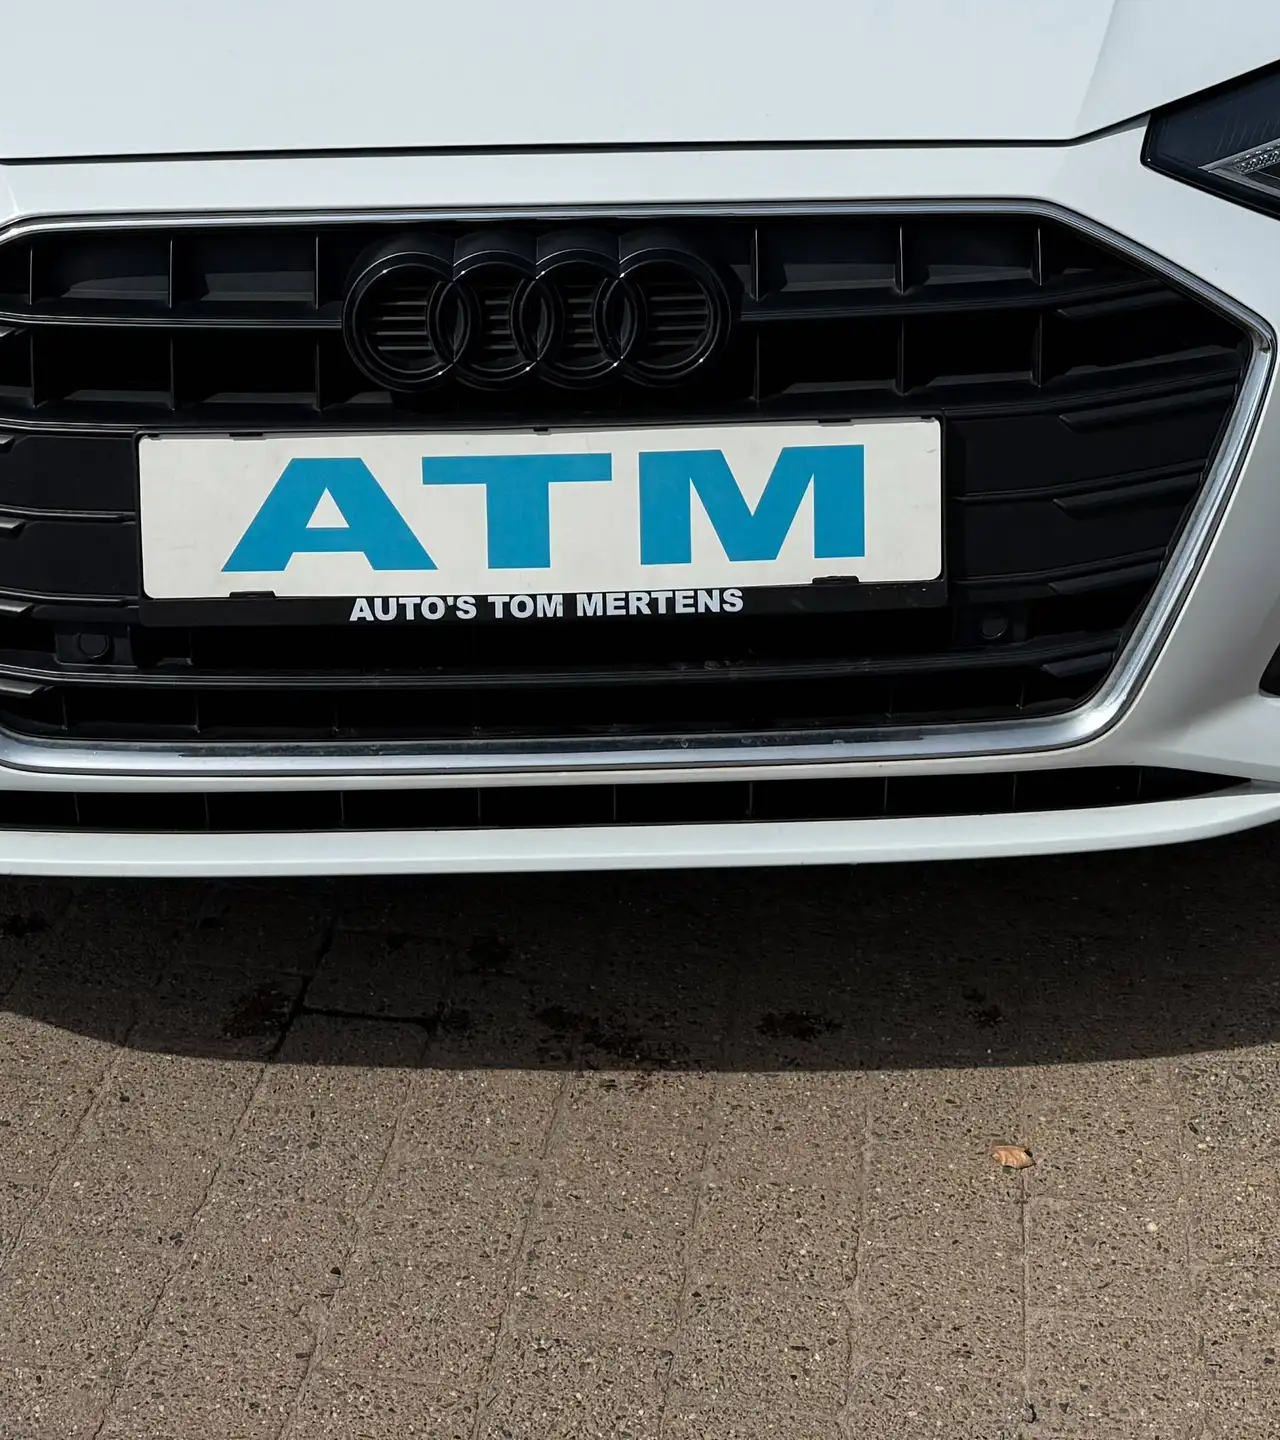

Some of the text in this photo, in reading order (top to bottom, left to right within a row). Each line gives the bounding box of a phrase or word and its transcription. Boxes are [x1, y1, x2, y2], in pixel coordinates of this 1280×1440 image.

[220, 444, 866, 572] ATM
[349, 588, 744, 621] AUTO'S TOM MERTENS
